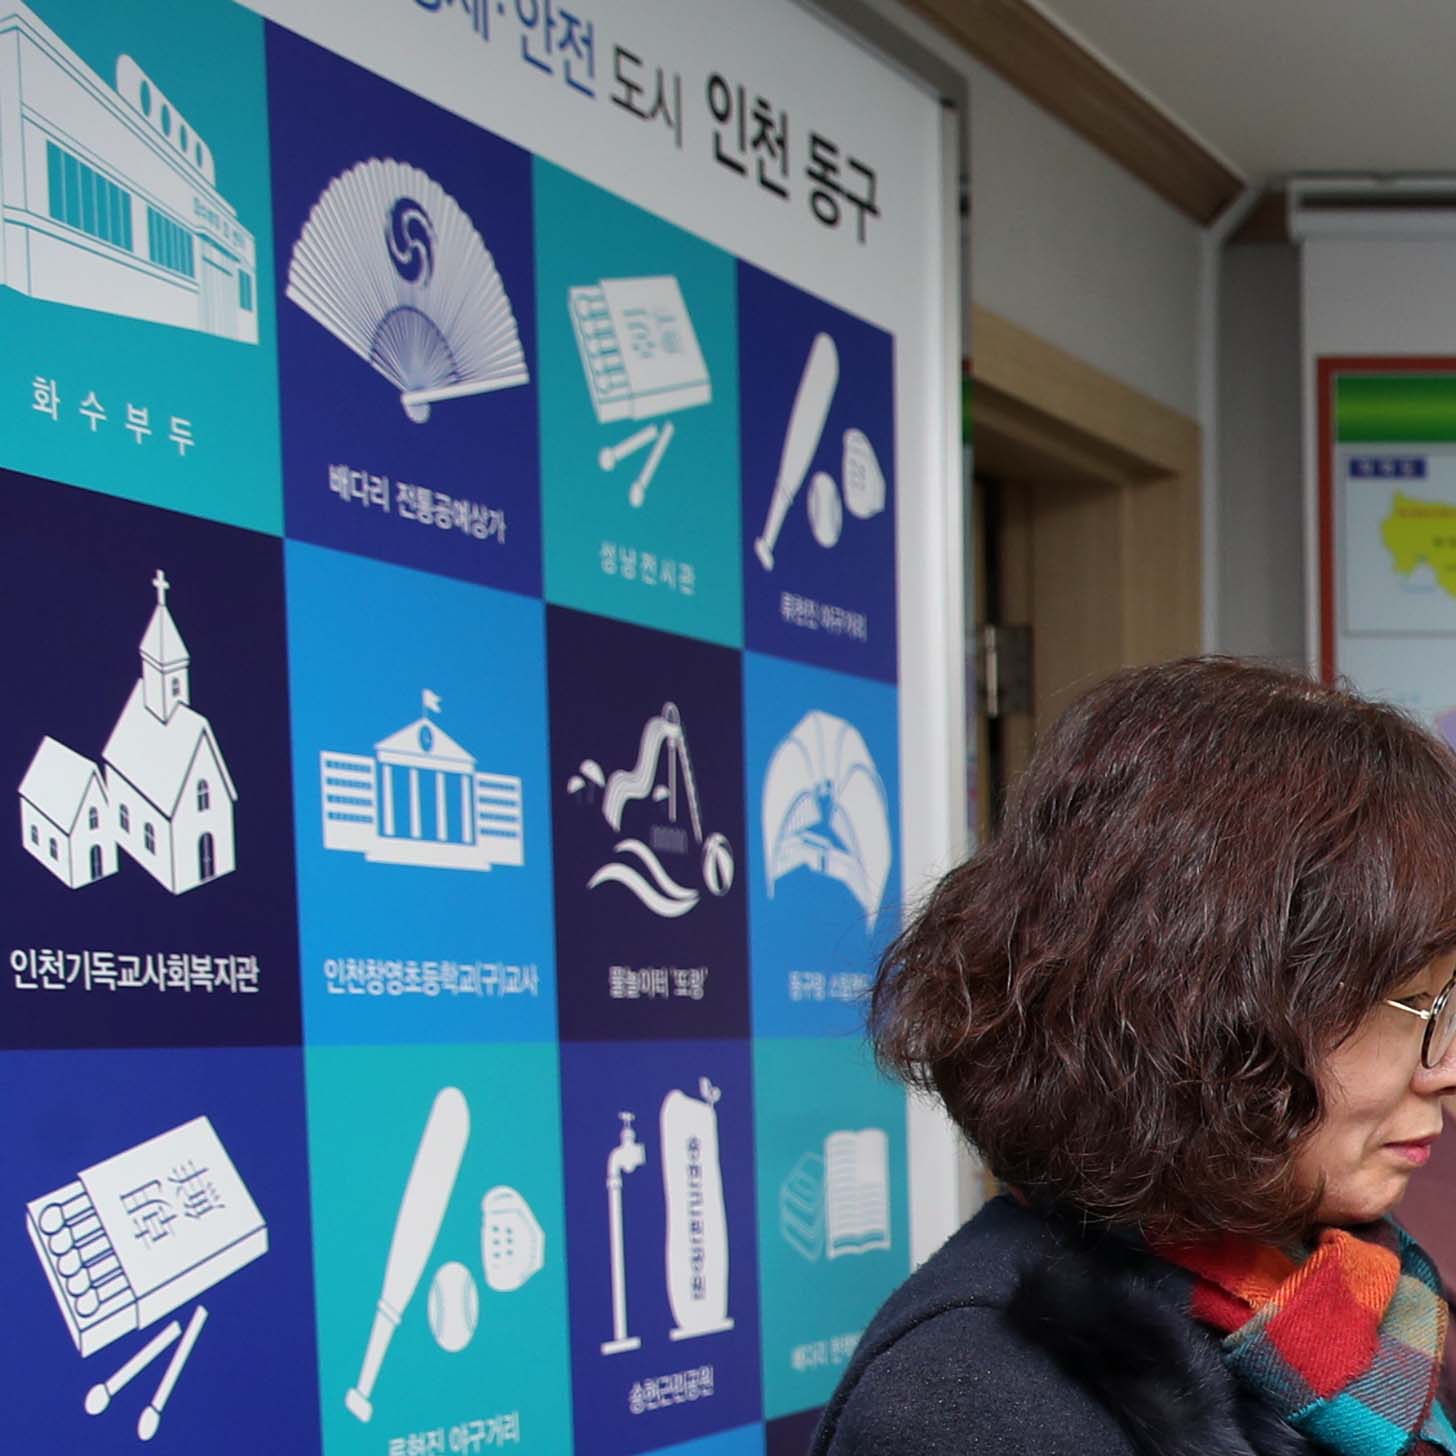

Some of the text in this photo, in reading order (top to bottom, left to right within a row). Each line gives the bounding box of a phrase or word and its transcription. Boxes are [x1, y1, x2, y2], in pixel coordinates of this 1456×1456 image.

[415, 0, 881, 246] ·안전 도시 인천 동구
[32, 375, 196, 457] 화수부두
[328, 463, 507, 545] 배다리 전통공예상가
[600, 540, 696, 596] 성냥전시관
[9, 948, 261, 993] 인천기독교사회복지관
[323, 958, 539, 997] 인천창영초등학교(구)교사
[448, 1410, 521, 1456] 야구거리
